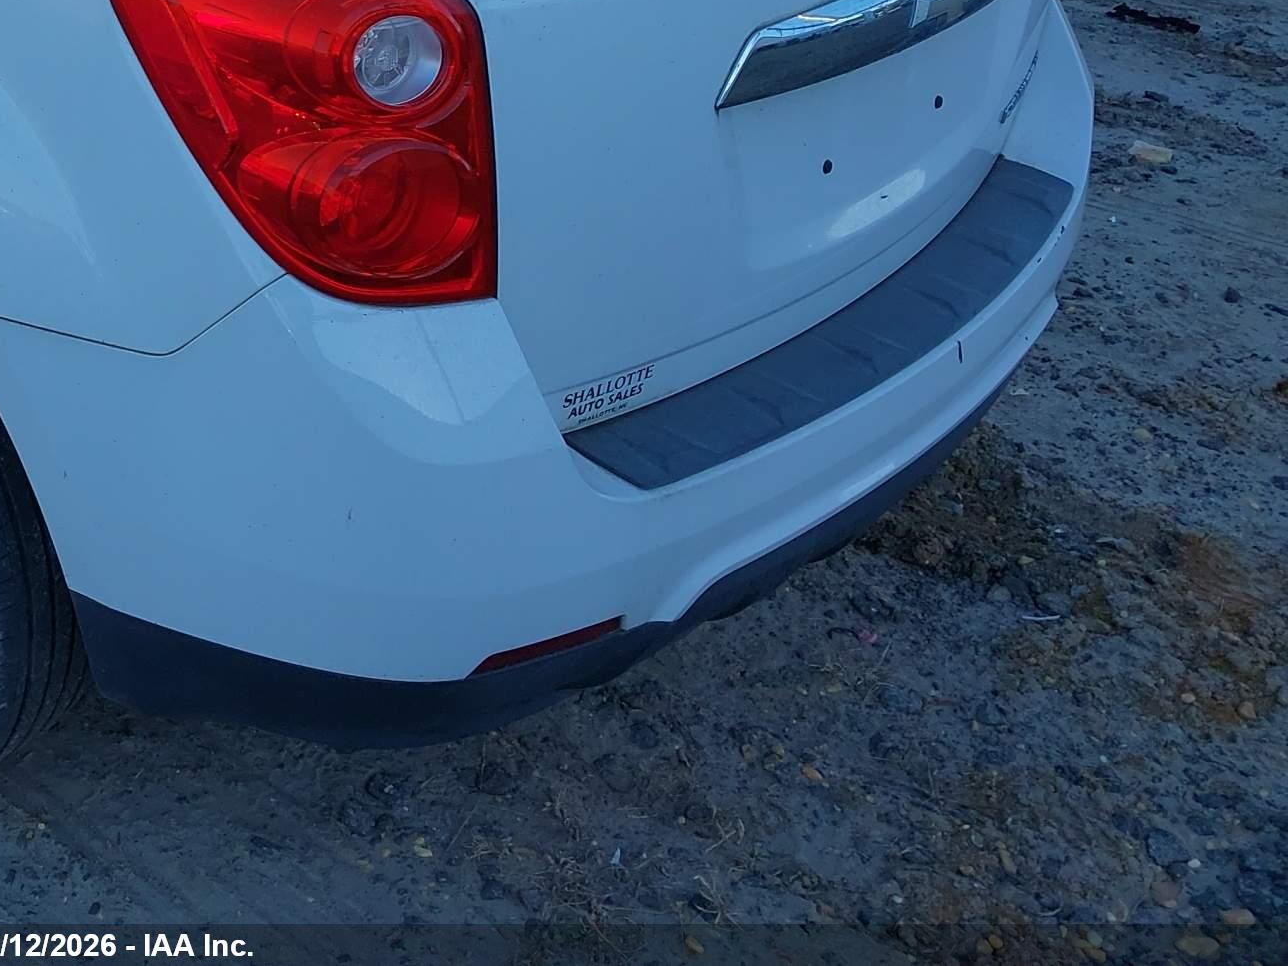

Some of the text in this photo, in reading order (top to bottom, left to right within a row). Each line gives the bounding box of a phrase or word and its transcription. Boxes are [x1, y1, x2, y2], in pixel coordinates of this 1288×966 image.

[562, 364, 655, 409] SHALLOTTE
[567, 384, 644, 420] AUTO SALES
